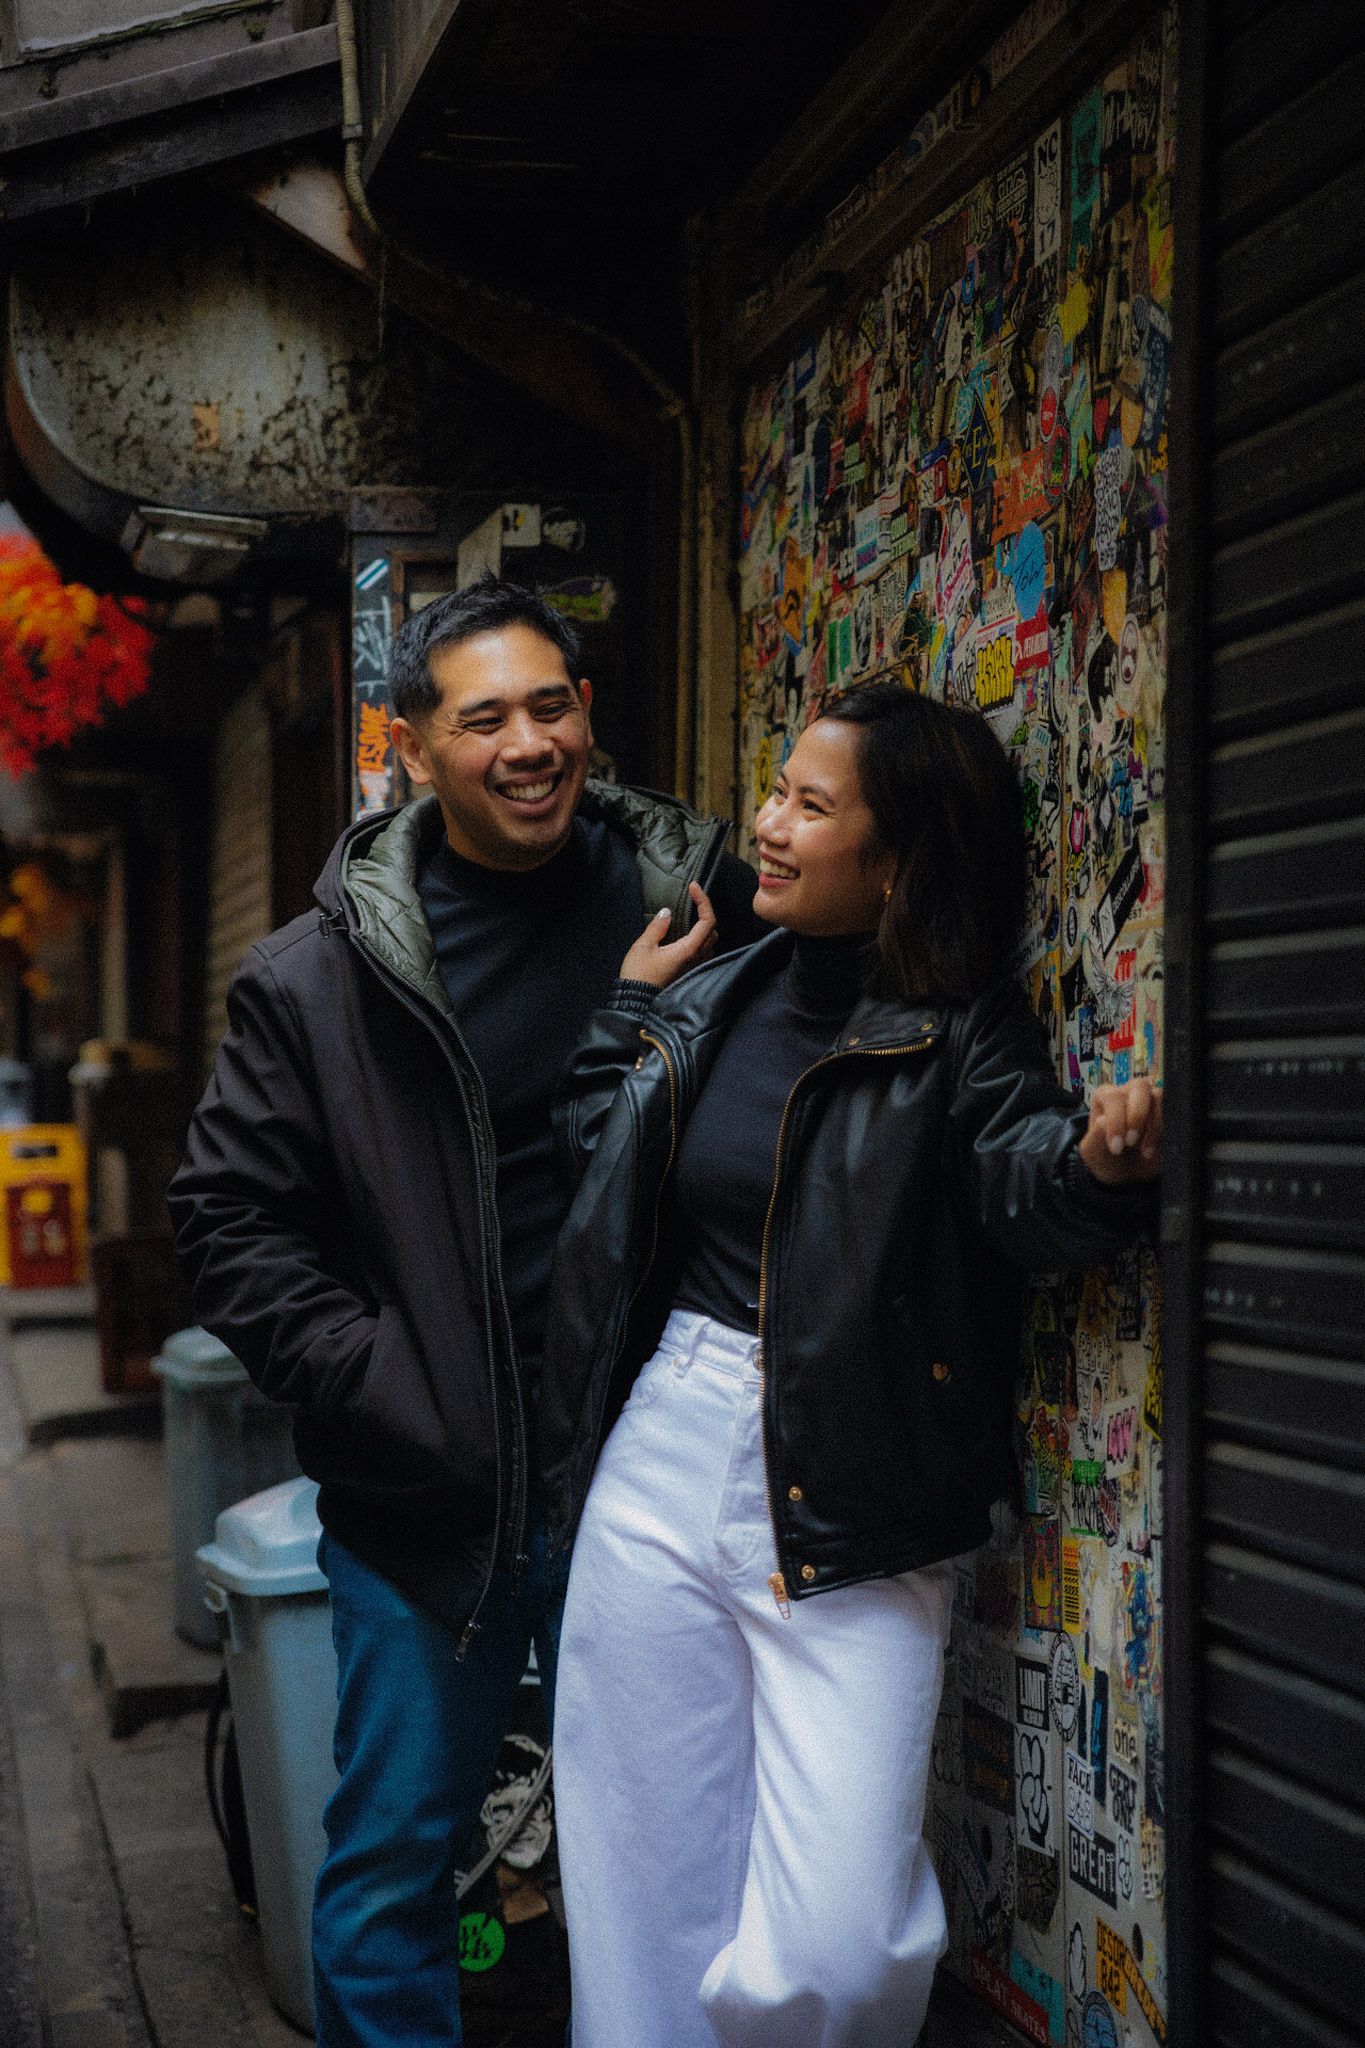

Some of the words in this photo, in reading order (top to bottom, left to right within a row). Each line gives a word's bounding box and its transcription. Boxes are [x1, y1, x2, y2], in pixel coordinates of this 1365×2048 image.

[1037, 131, 1058, 175] NC
[1038, 219, 1058, 255] 17
[1068, 1757, 1091, 1795] FACE
